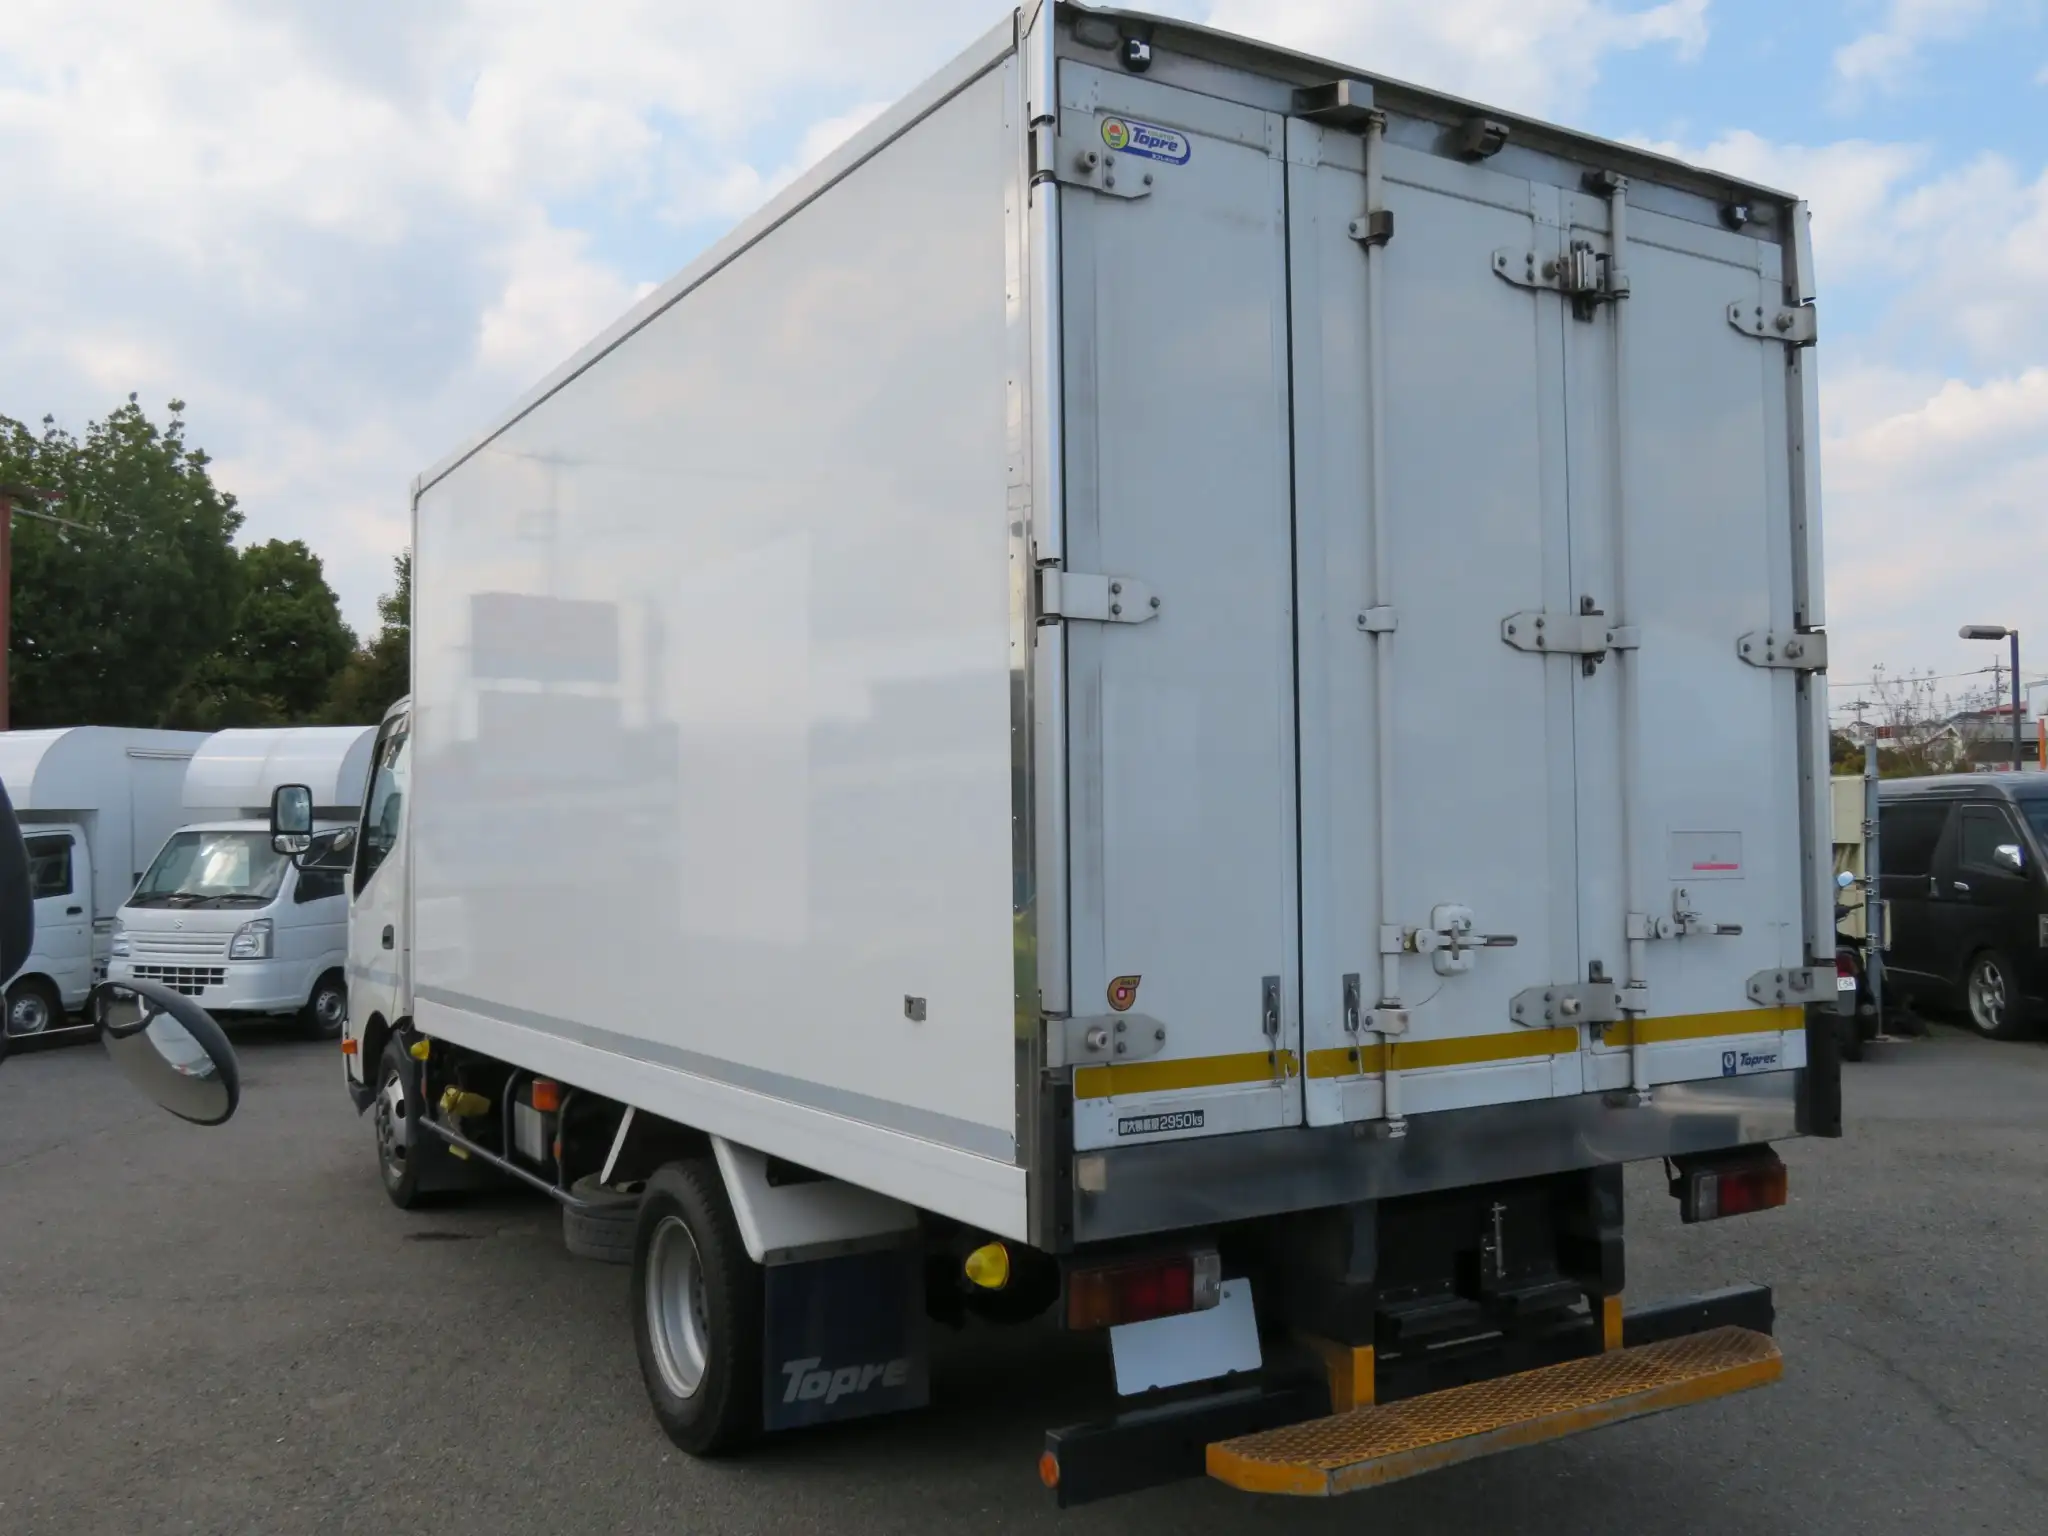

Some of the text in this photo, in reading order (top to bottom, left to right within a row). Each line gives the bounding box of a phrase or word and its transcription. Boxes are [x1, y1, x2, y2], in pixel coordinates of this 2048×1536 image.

[1132, 126, 1179, 152] Topre
[1160, 1112, 1203, 1130] 2950kg
[782, 1356, 911, 1405] Topre
